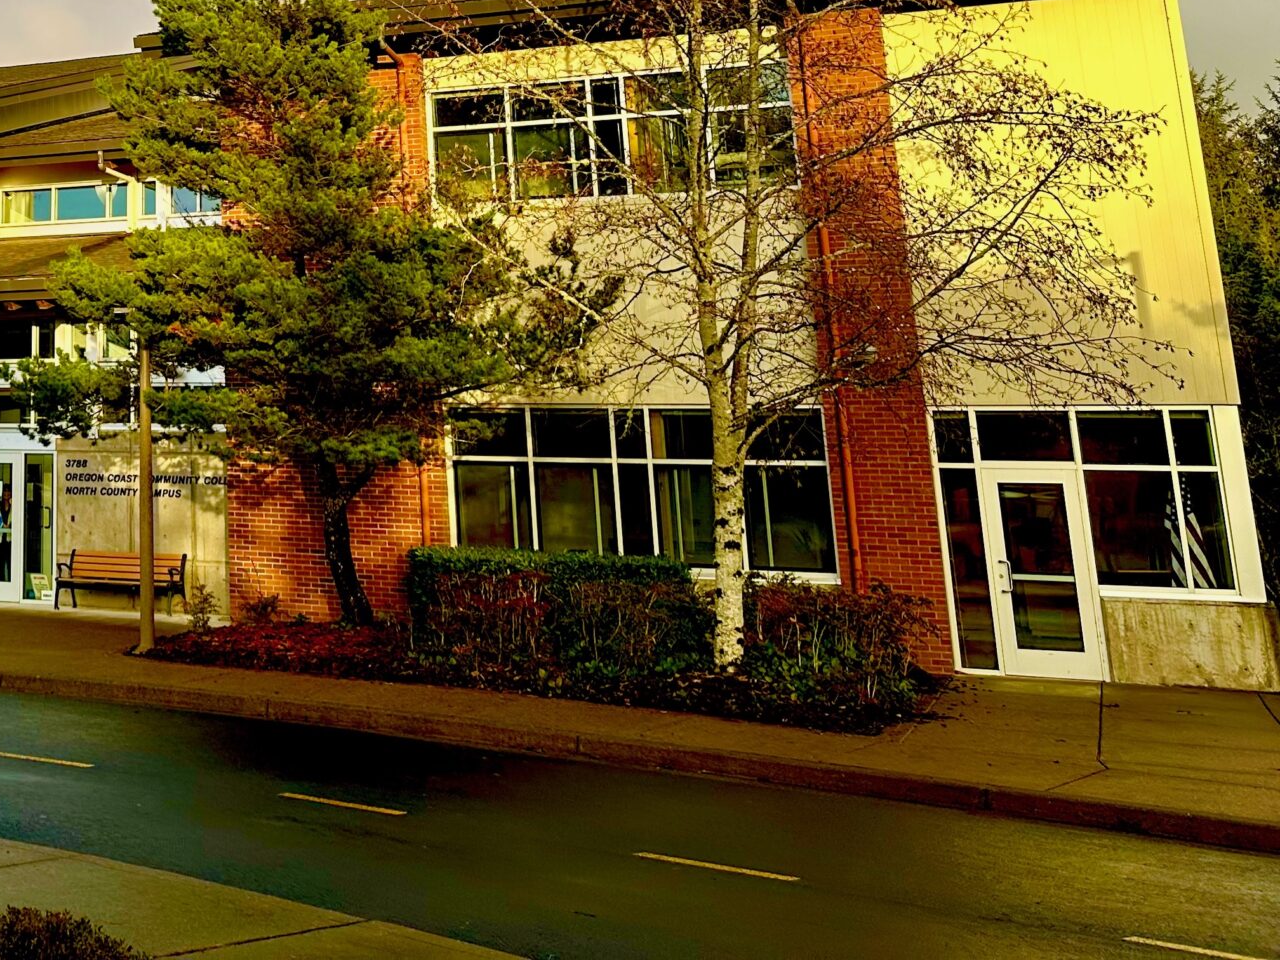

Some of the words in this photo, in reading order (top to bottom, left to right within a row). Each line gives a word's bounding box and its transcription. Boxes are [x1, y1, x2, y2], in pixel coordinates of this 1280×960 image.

[65, 459, 88, 468] 3788
[65, 473, 104, 482] OREGON
[107, 474, 138, 483] COAST
[152, 475, 200, 485] MMUNITY
[203, 476, 228, 486] COLL
[65, 486, 97, 496] NORTH
[100, 487, 138, 496] COUNTY
[153, 489, 181, 498] MPUS
